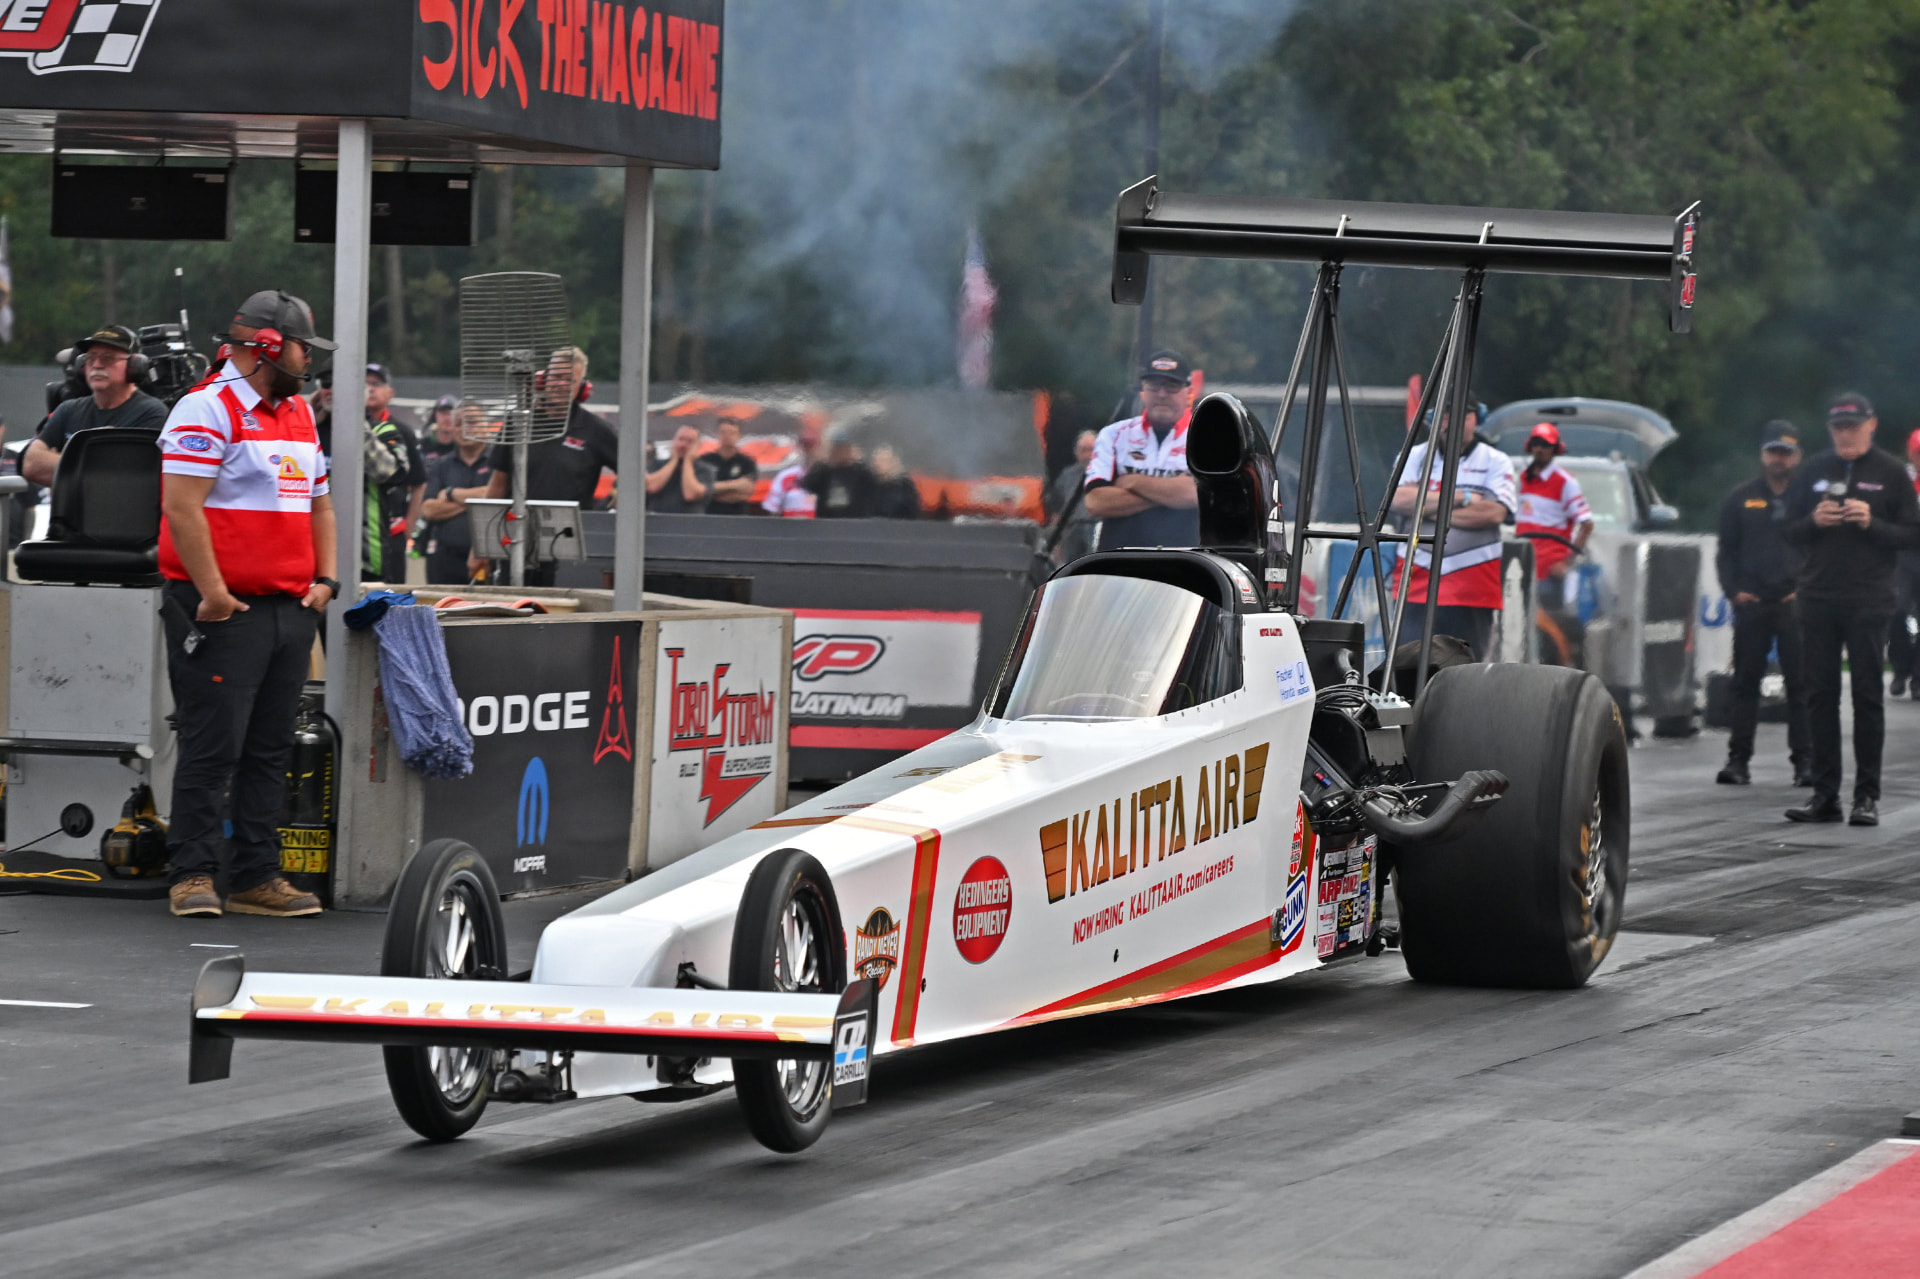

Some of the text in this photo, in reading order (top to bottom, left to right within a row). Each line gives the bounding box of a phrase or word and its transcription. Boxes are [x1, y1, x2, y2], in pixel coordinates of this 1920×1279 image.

[419, 0, 719, 120] SICK THE MAGAZINE
[457, 691, 590, 736] ODGE
[791, 693, 907, 718] LATINUM
[281, 829, 329, 847] RNING
[1070, 754, 1240, 896] KALITTA AIR
[513, 855, 547, 874] MOPAR
[958, 875, 1009, 909] HEDINGER'S
[1072, 855, 1234, 945] NOW HIRING KALITTAAIR.com/careers
[1318, 878, 1342, 905] ARP
[956, 909, 1007, 942] EQUIPMENT
[1283, 887, 1304, 932] GUNK
[856, 930, 898, 962] RANDY MEYER
[865, 963, 886, 978] Racing
[324, 997, 605, 1020] KALITTA
[835, 1061, 865, 1082] CARRILLO
